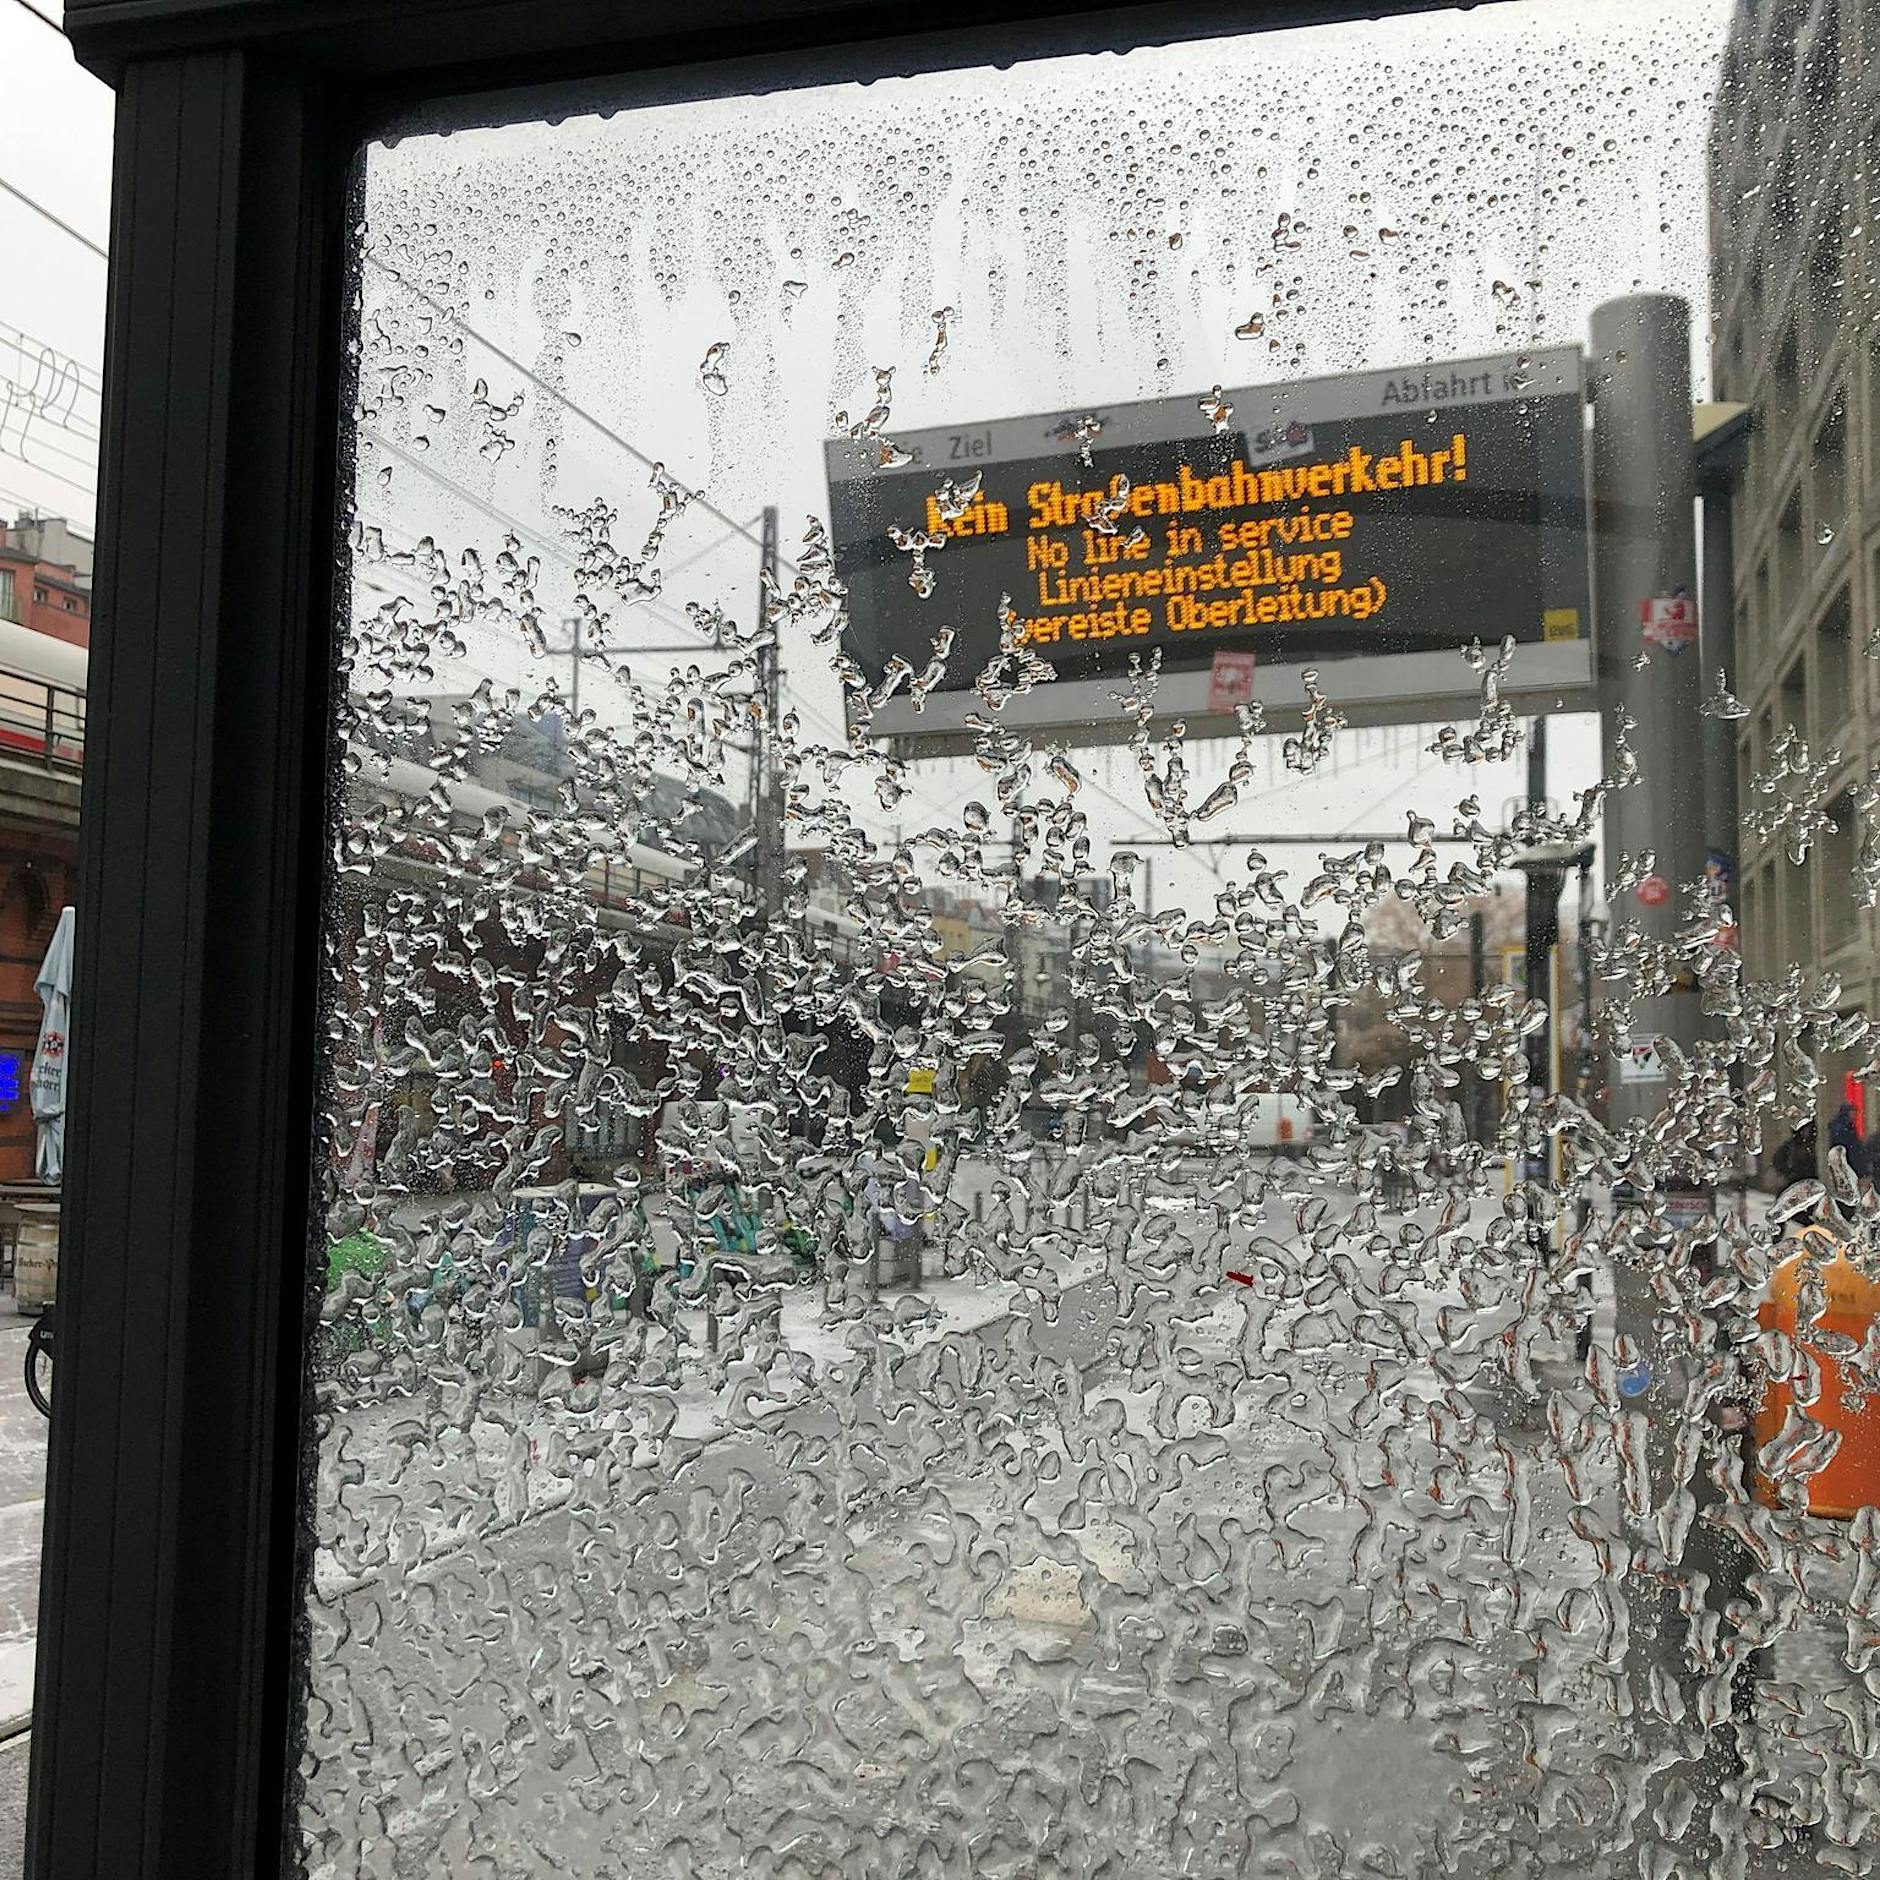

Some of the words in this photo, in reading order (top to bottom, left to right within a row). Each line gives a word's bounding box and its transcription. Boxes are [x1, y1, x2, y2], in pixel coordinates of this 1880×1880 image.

[1381, 372, 1492, 407] Abfahrt
[949, 430, 992, 460] Ziel
[1026, 533, 1069, 570] No
[1081, 528, 1151, 565] line
[1164, 516, 1202, 557] in
[1218, 505, 1354, 551] service
[1038, 548, 1343, 607] Linieneinstellung
